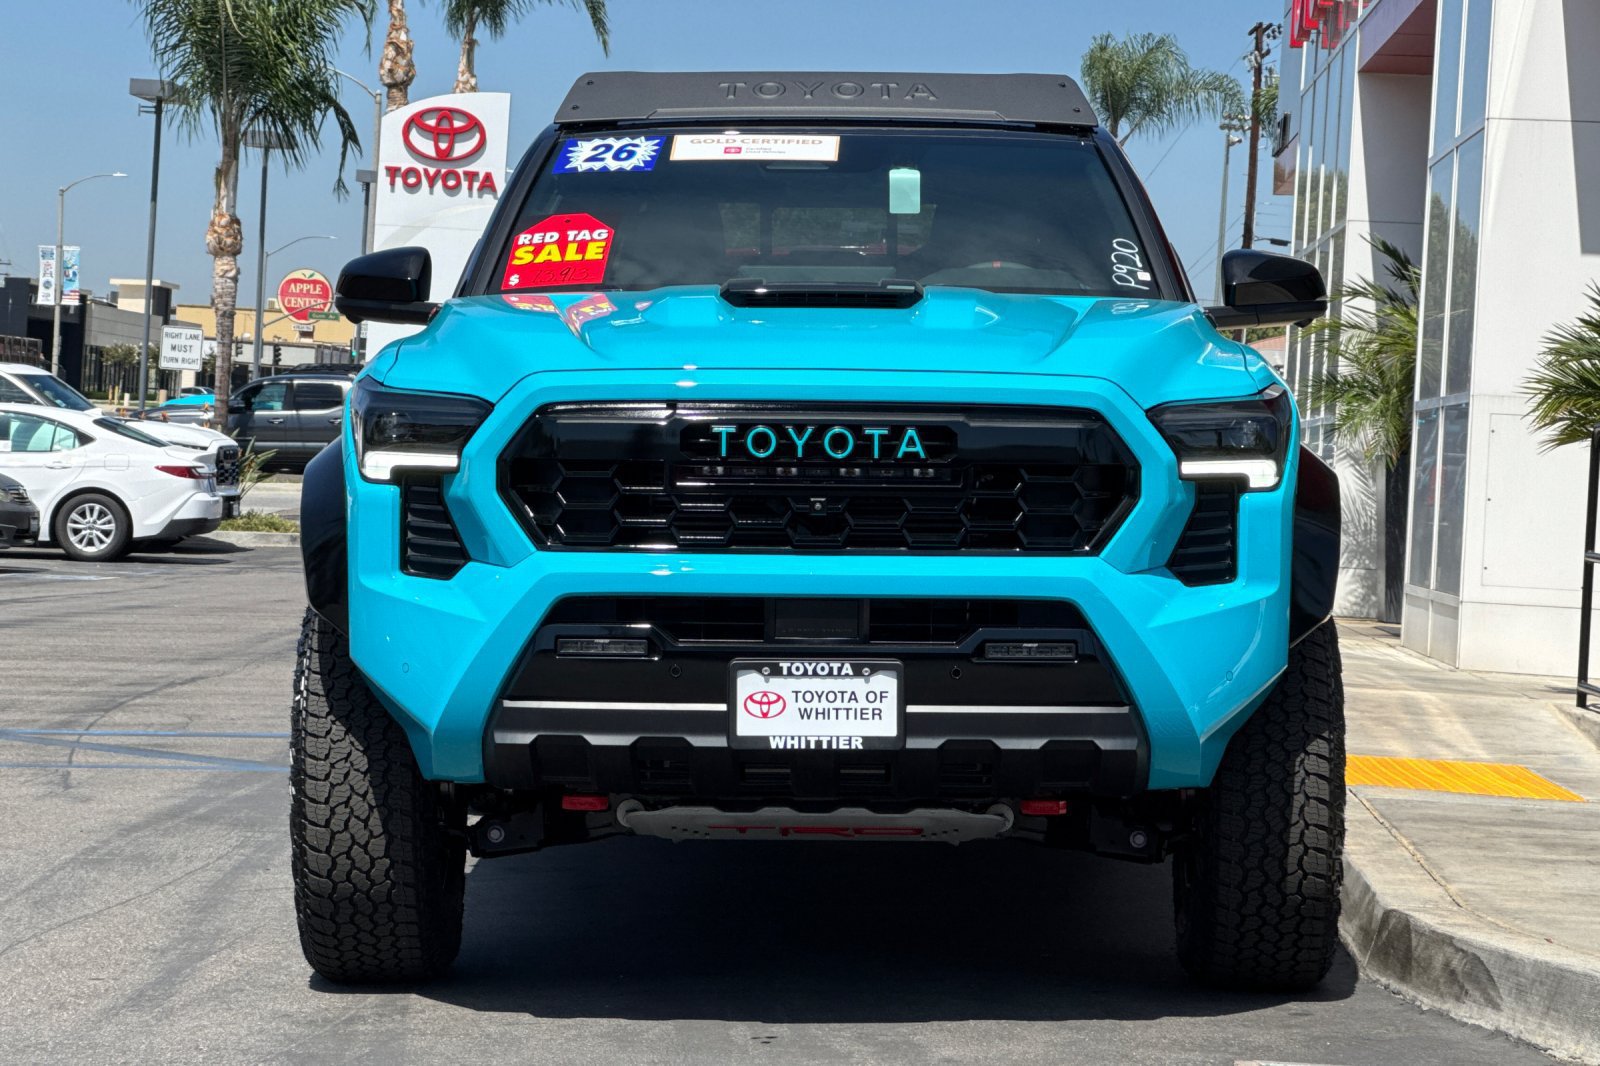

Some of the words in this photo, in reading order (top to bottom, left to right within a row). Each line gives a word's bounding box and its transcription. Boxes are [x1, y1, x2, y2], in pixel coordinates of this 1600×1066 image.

[718, 81, 939, 100] TOYOTA
[582, 142, 638, 163] 26
[385, 165, 498, 193] TOYOTA
[517, 231, 560, 245] RED
[567, 229, 609, 241] TAG
[511, 241, 607, 266] SALE
[288, 282, 323, 295] APPLE
[284, 296, 324, 309] CENTER
[164, 331, 182, 340] RIGHT
[185, 332, 201, 341] LANE
[170, 343, 193, 353] MUST
[163, 355, 179, 364] TURN
[181, 356, 199, 365] RIGHT
[711, 425, 926, 459] TOYOTA
[779, 662, 854, 676] TOYOTA
[792, 690, 859, 704] TOYOTA
[865, 690, 889, 704] OF
[798, 707, 883, 721] WHITTIER
[769, 736, 864, 750] WHITTIER
